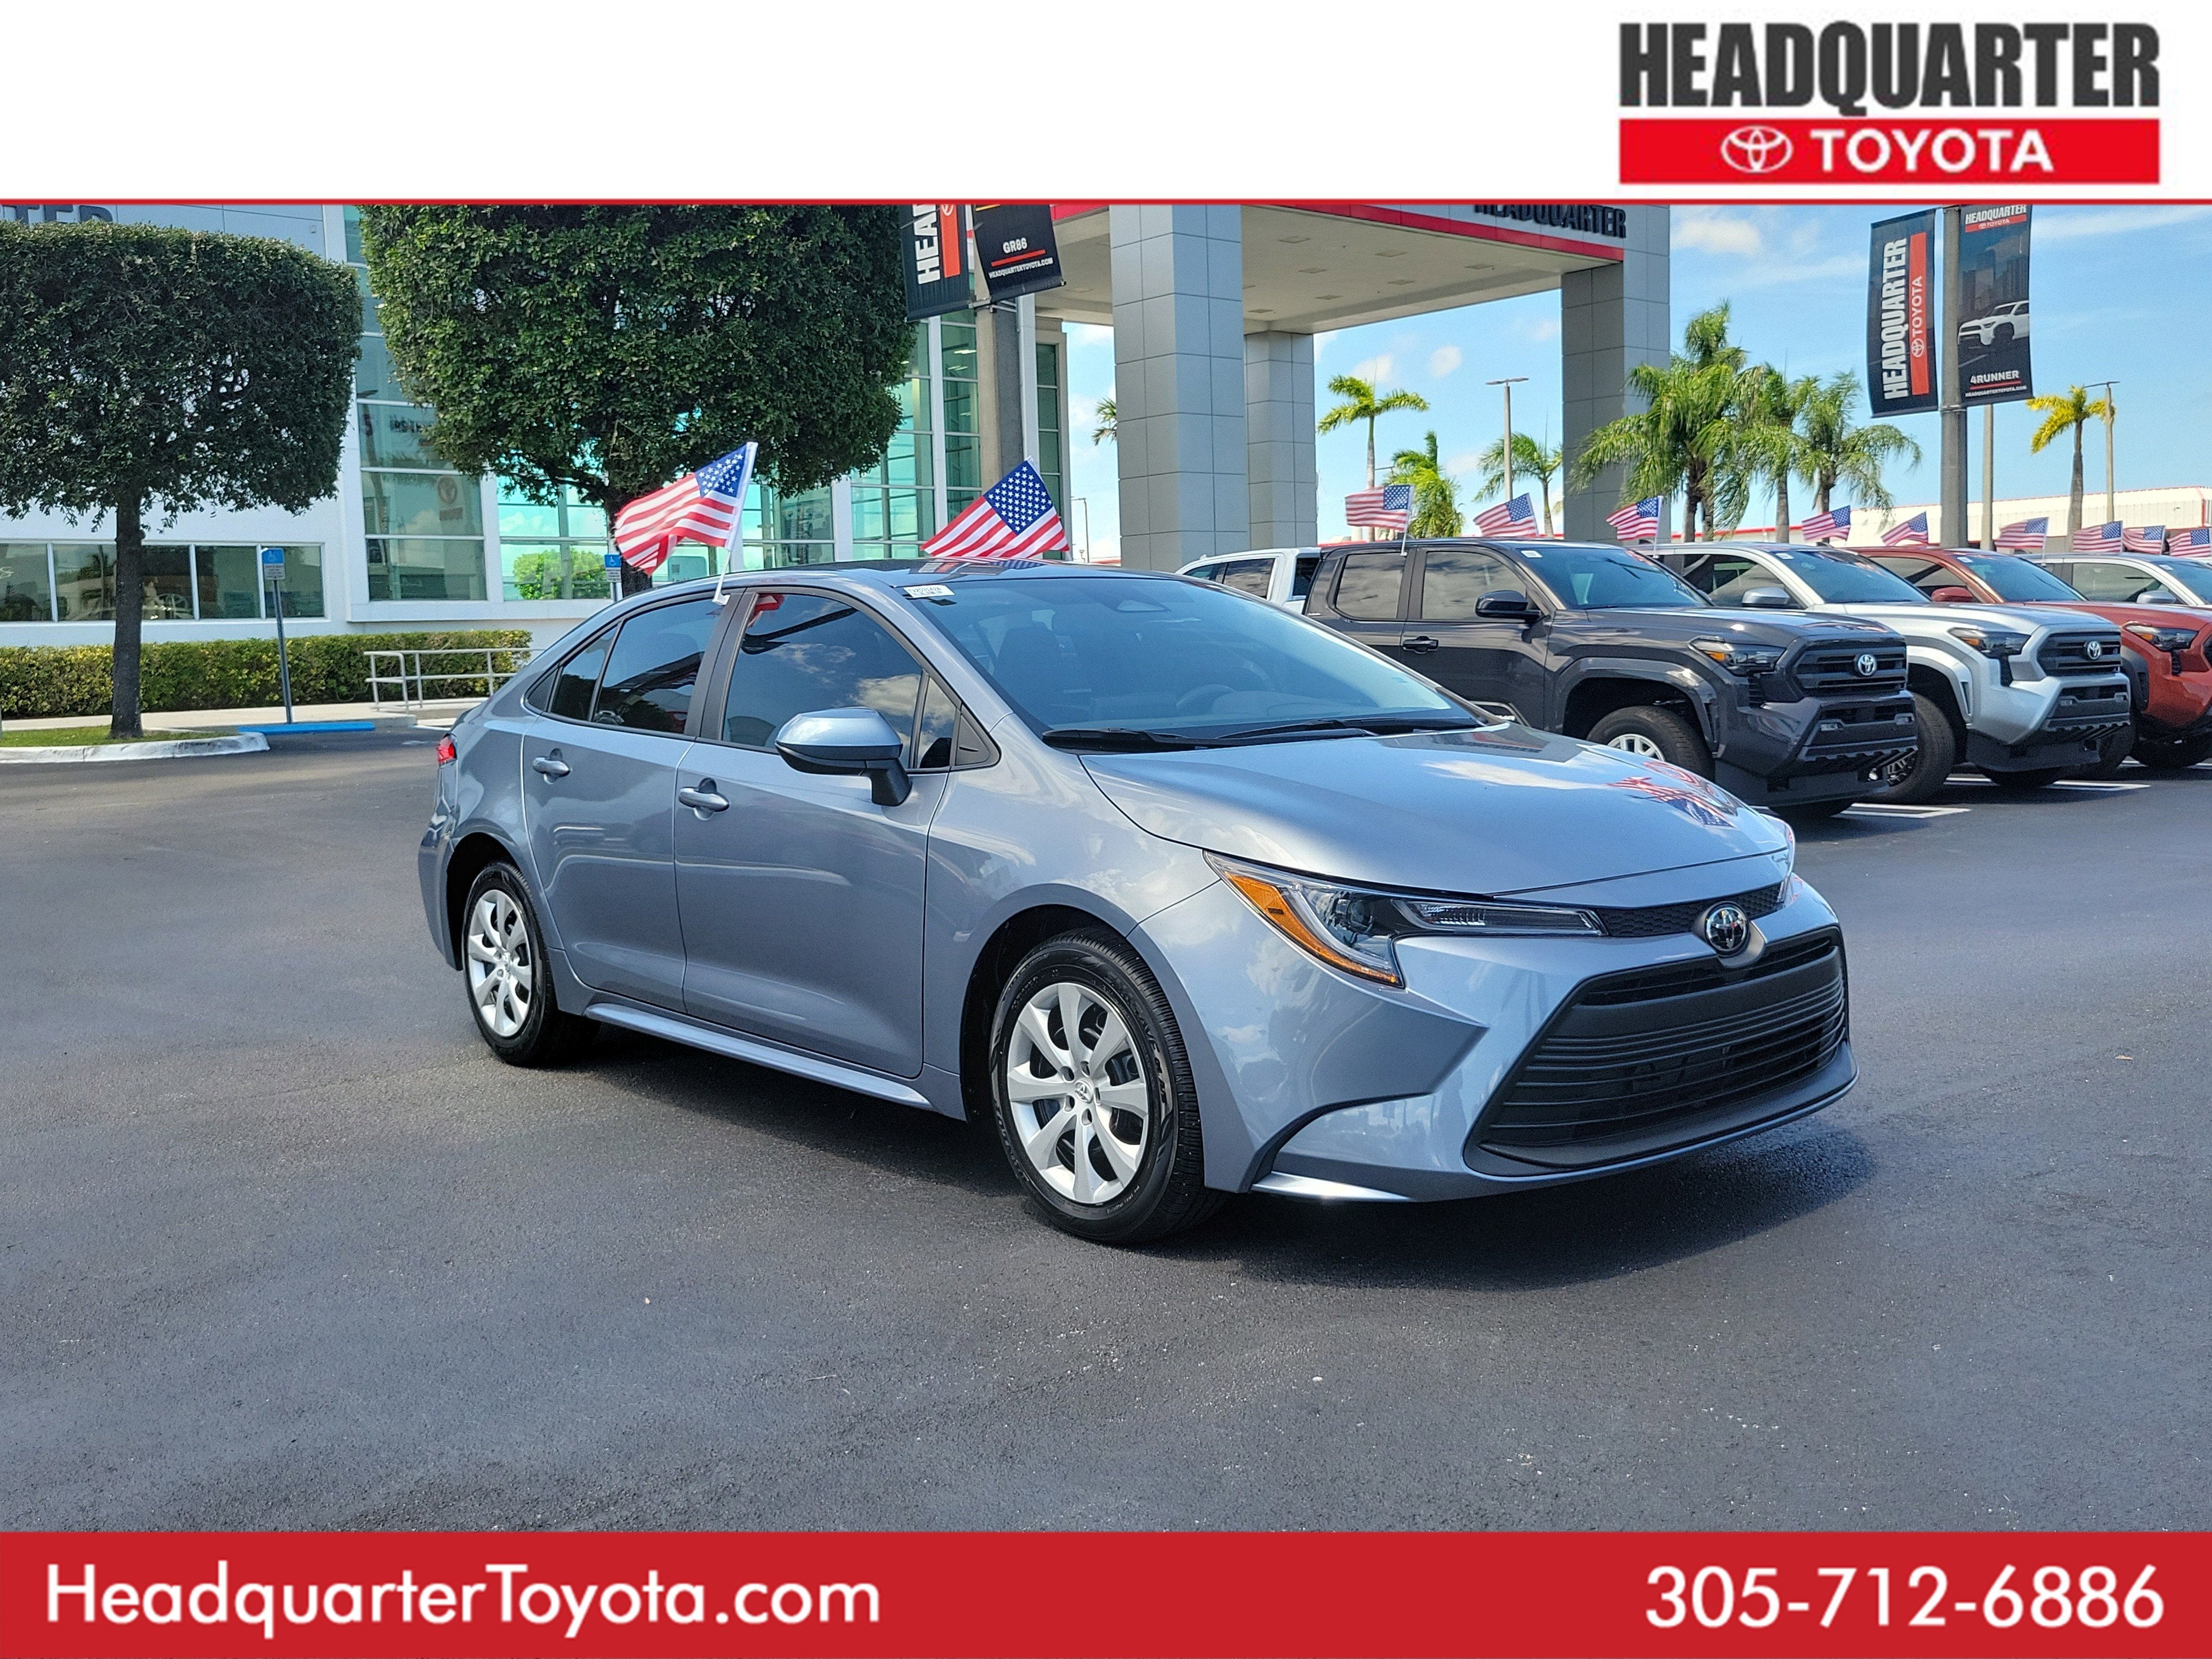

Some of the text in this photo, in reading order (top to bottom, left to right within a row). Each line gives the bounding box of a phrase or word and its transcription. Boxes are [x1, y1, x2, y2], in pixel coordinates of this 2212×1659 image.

[1965, 204, 2027, 225] HEADQUARTER
[1987, 219, 2010, 228] TOYOTA
[1002, 237, 1028, 253] GR86
[988, 257, 1053, 279] HEADQUARTERTOYOTA.COM
[1911, 275, 1923, 337] TOYOTA
[1881, 238, 1909, 399] HEADQUARTER
[1970, 370, 2019, 384] 4RUNNER
